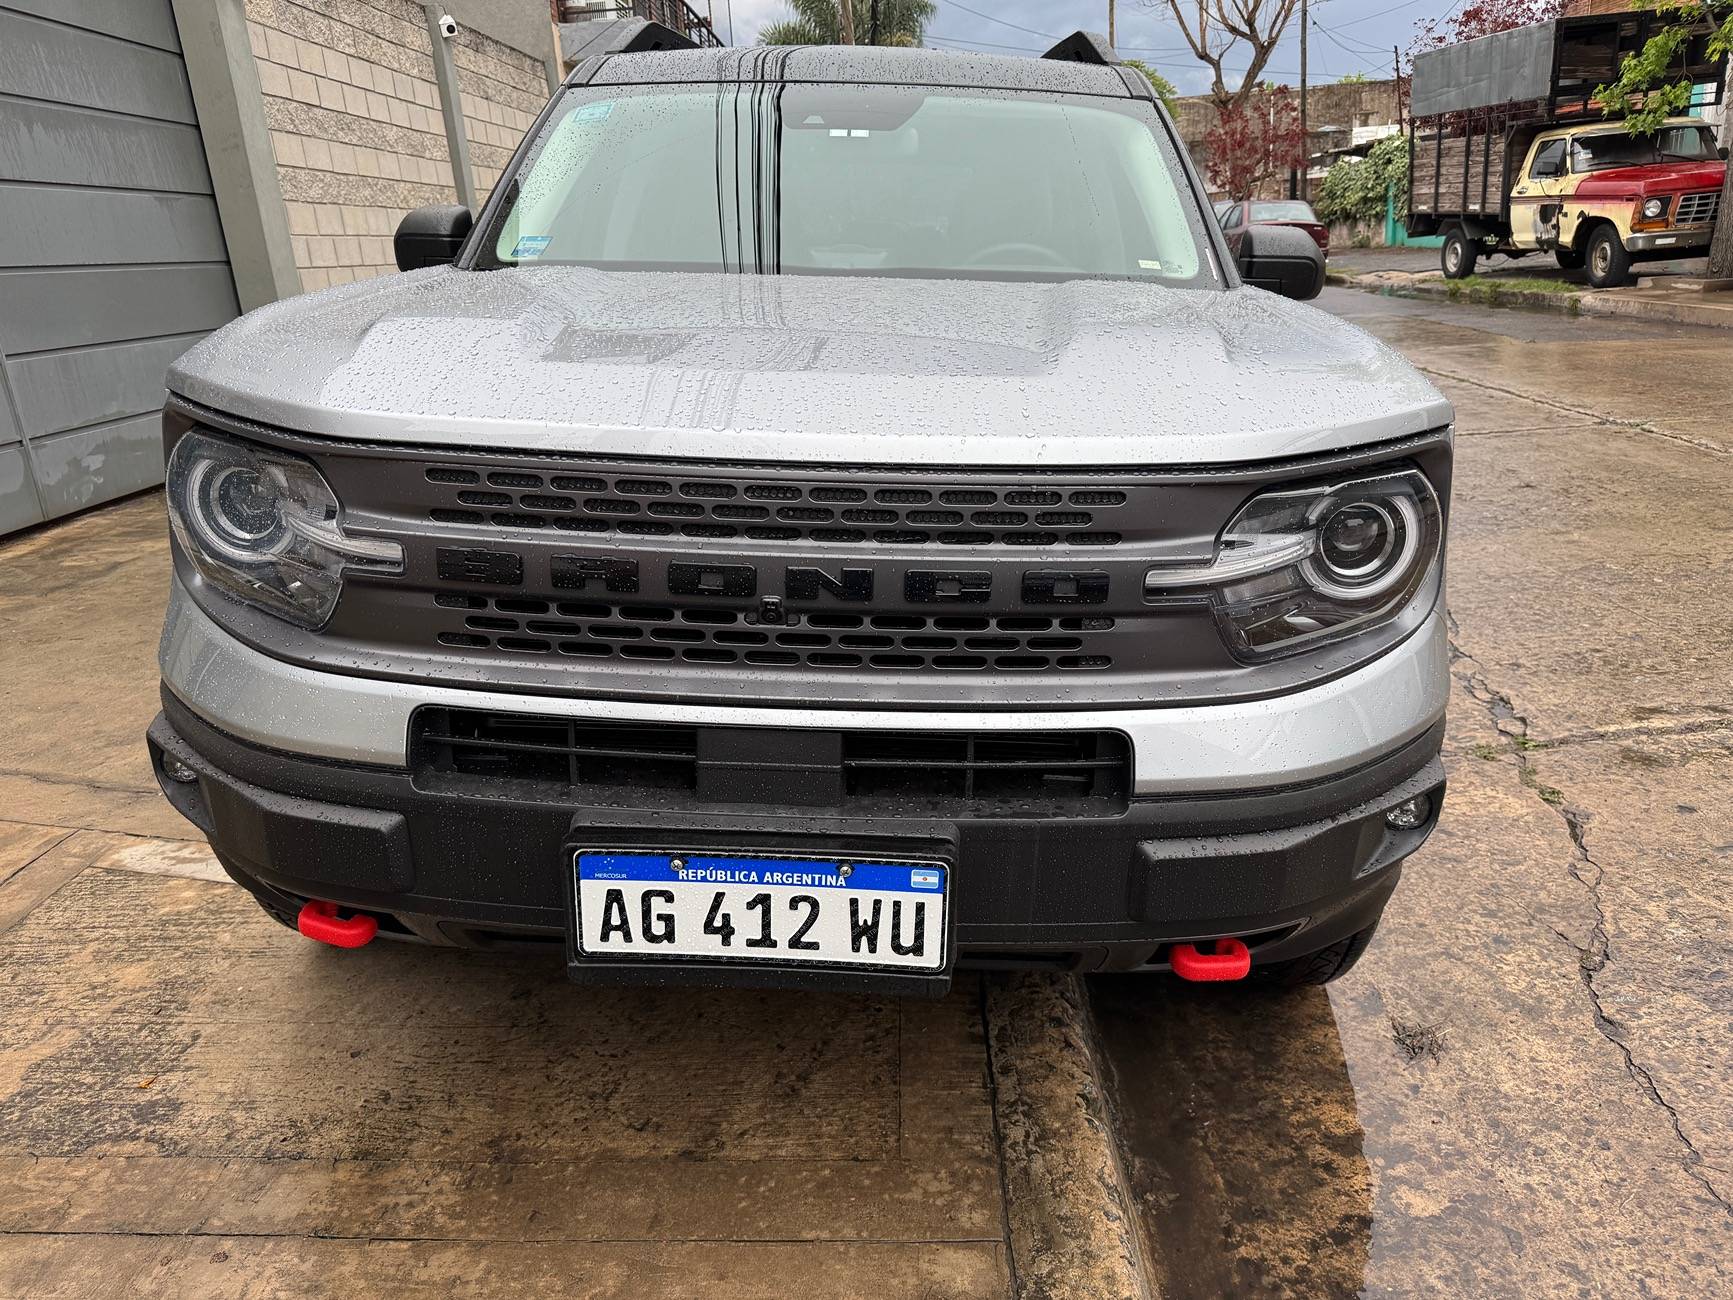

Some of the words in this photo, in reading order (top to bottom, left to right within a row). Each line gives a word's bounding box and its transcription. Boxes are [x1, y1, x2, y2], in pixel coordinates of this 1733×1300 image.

[436, 546, 1111, 602] BRONCO
[678, 866, 759, 883] REPÚBLICA
[763, 871, 847, 887] ARGENTINA
[599, 888, 676, 944] AG
[702, 891, 820, 951] 412
[848, 897, 926, 957] WU
